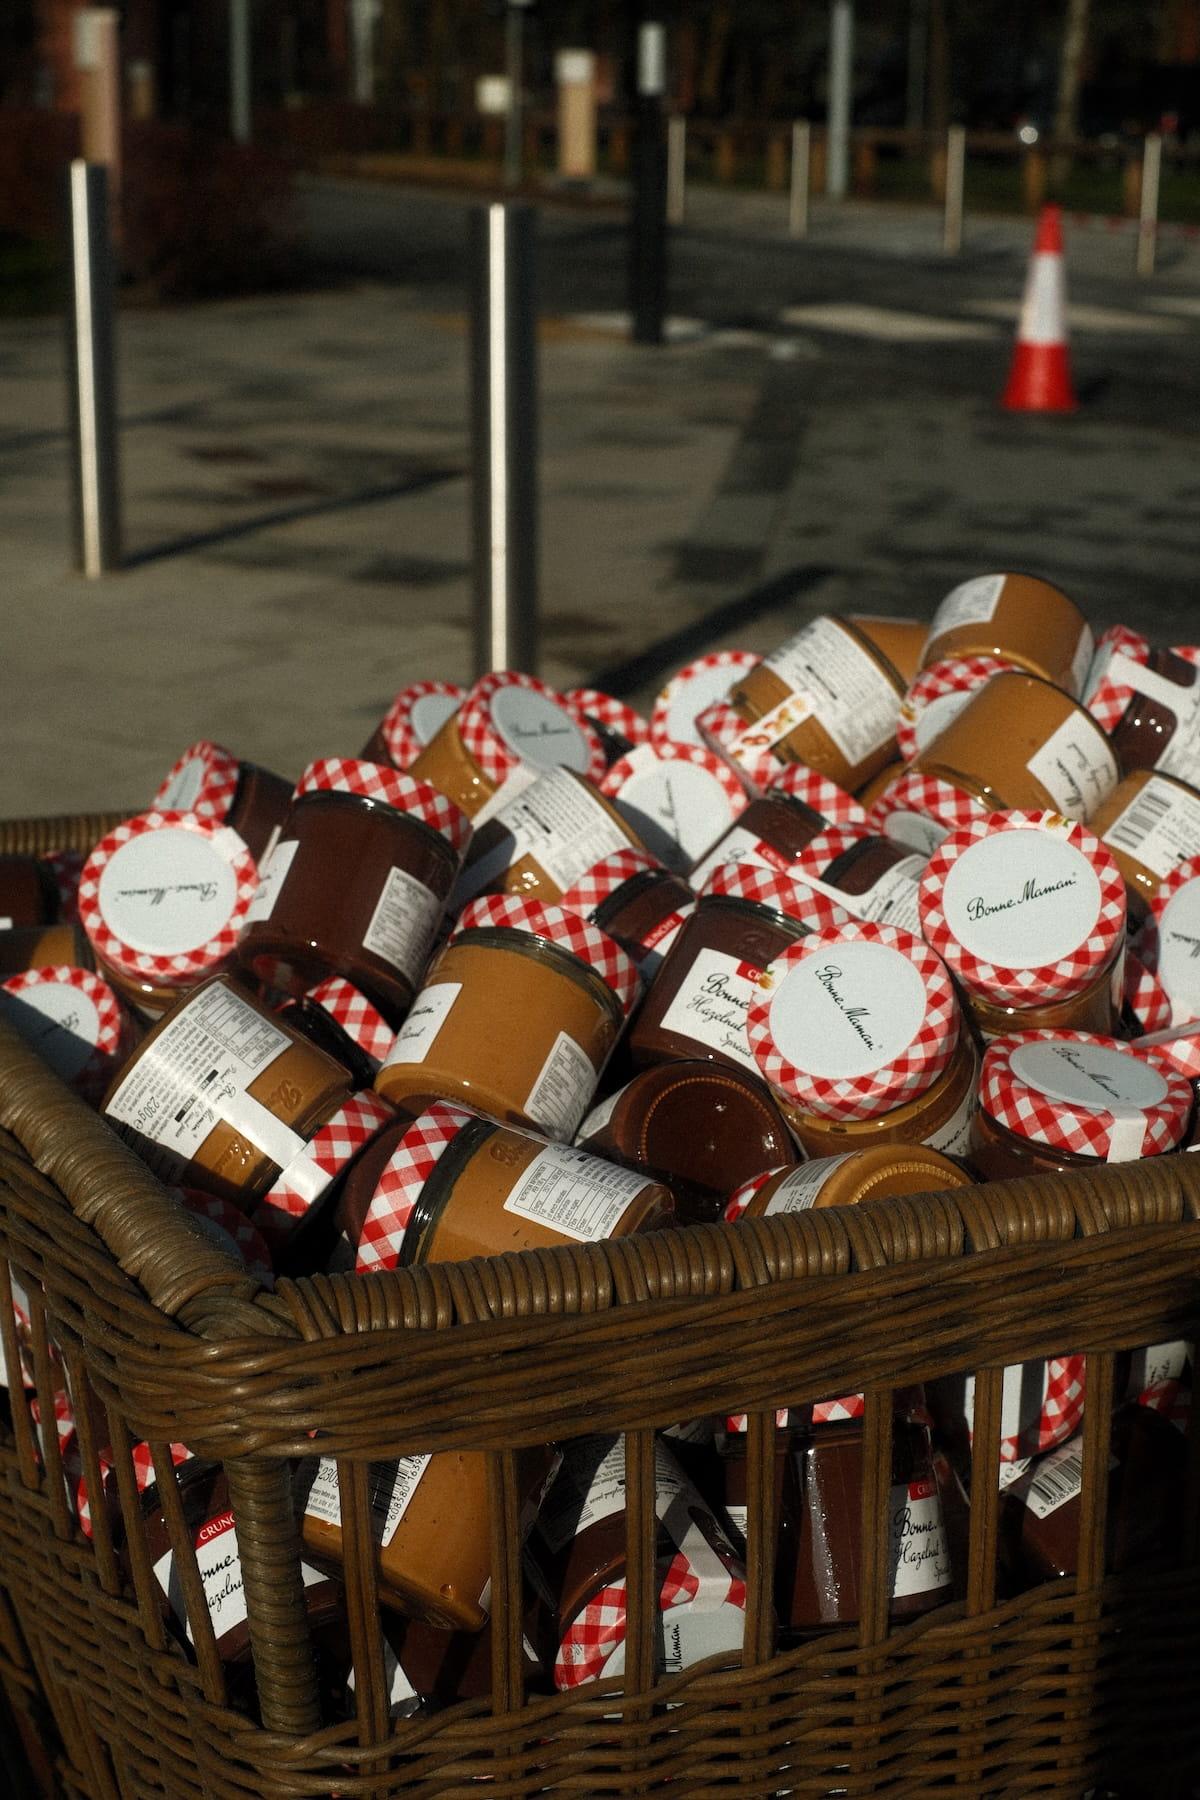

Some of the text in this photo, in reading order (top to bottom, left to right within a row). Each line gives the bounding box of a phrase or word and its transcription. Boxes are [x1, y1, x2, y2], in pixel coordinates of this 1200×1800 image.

[967, 878, 1076, 920] Bonne Maman
[701, 973, 750, 1009] Bonne
[815, 965, 874, 1051] Bonne Maman
[687, 994, 747, 1032] Hazelnut
[138, 1096, 160, 1120] 230g
[389, 1485, 411, 1520] 608580
[893, 1507, 937, 1539] Bonne
[202, 1555, 235, 1583] onne
[897, 1538, 939, 1570] Hazelnut
[208, 1573, 244, 1613] azelnu
[660, 1623, 683, 1671] Maman
